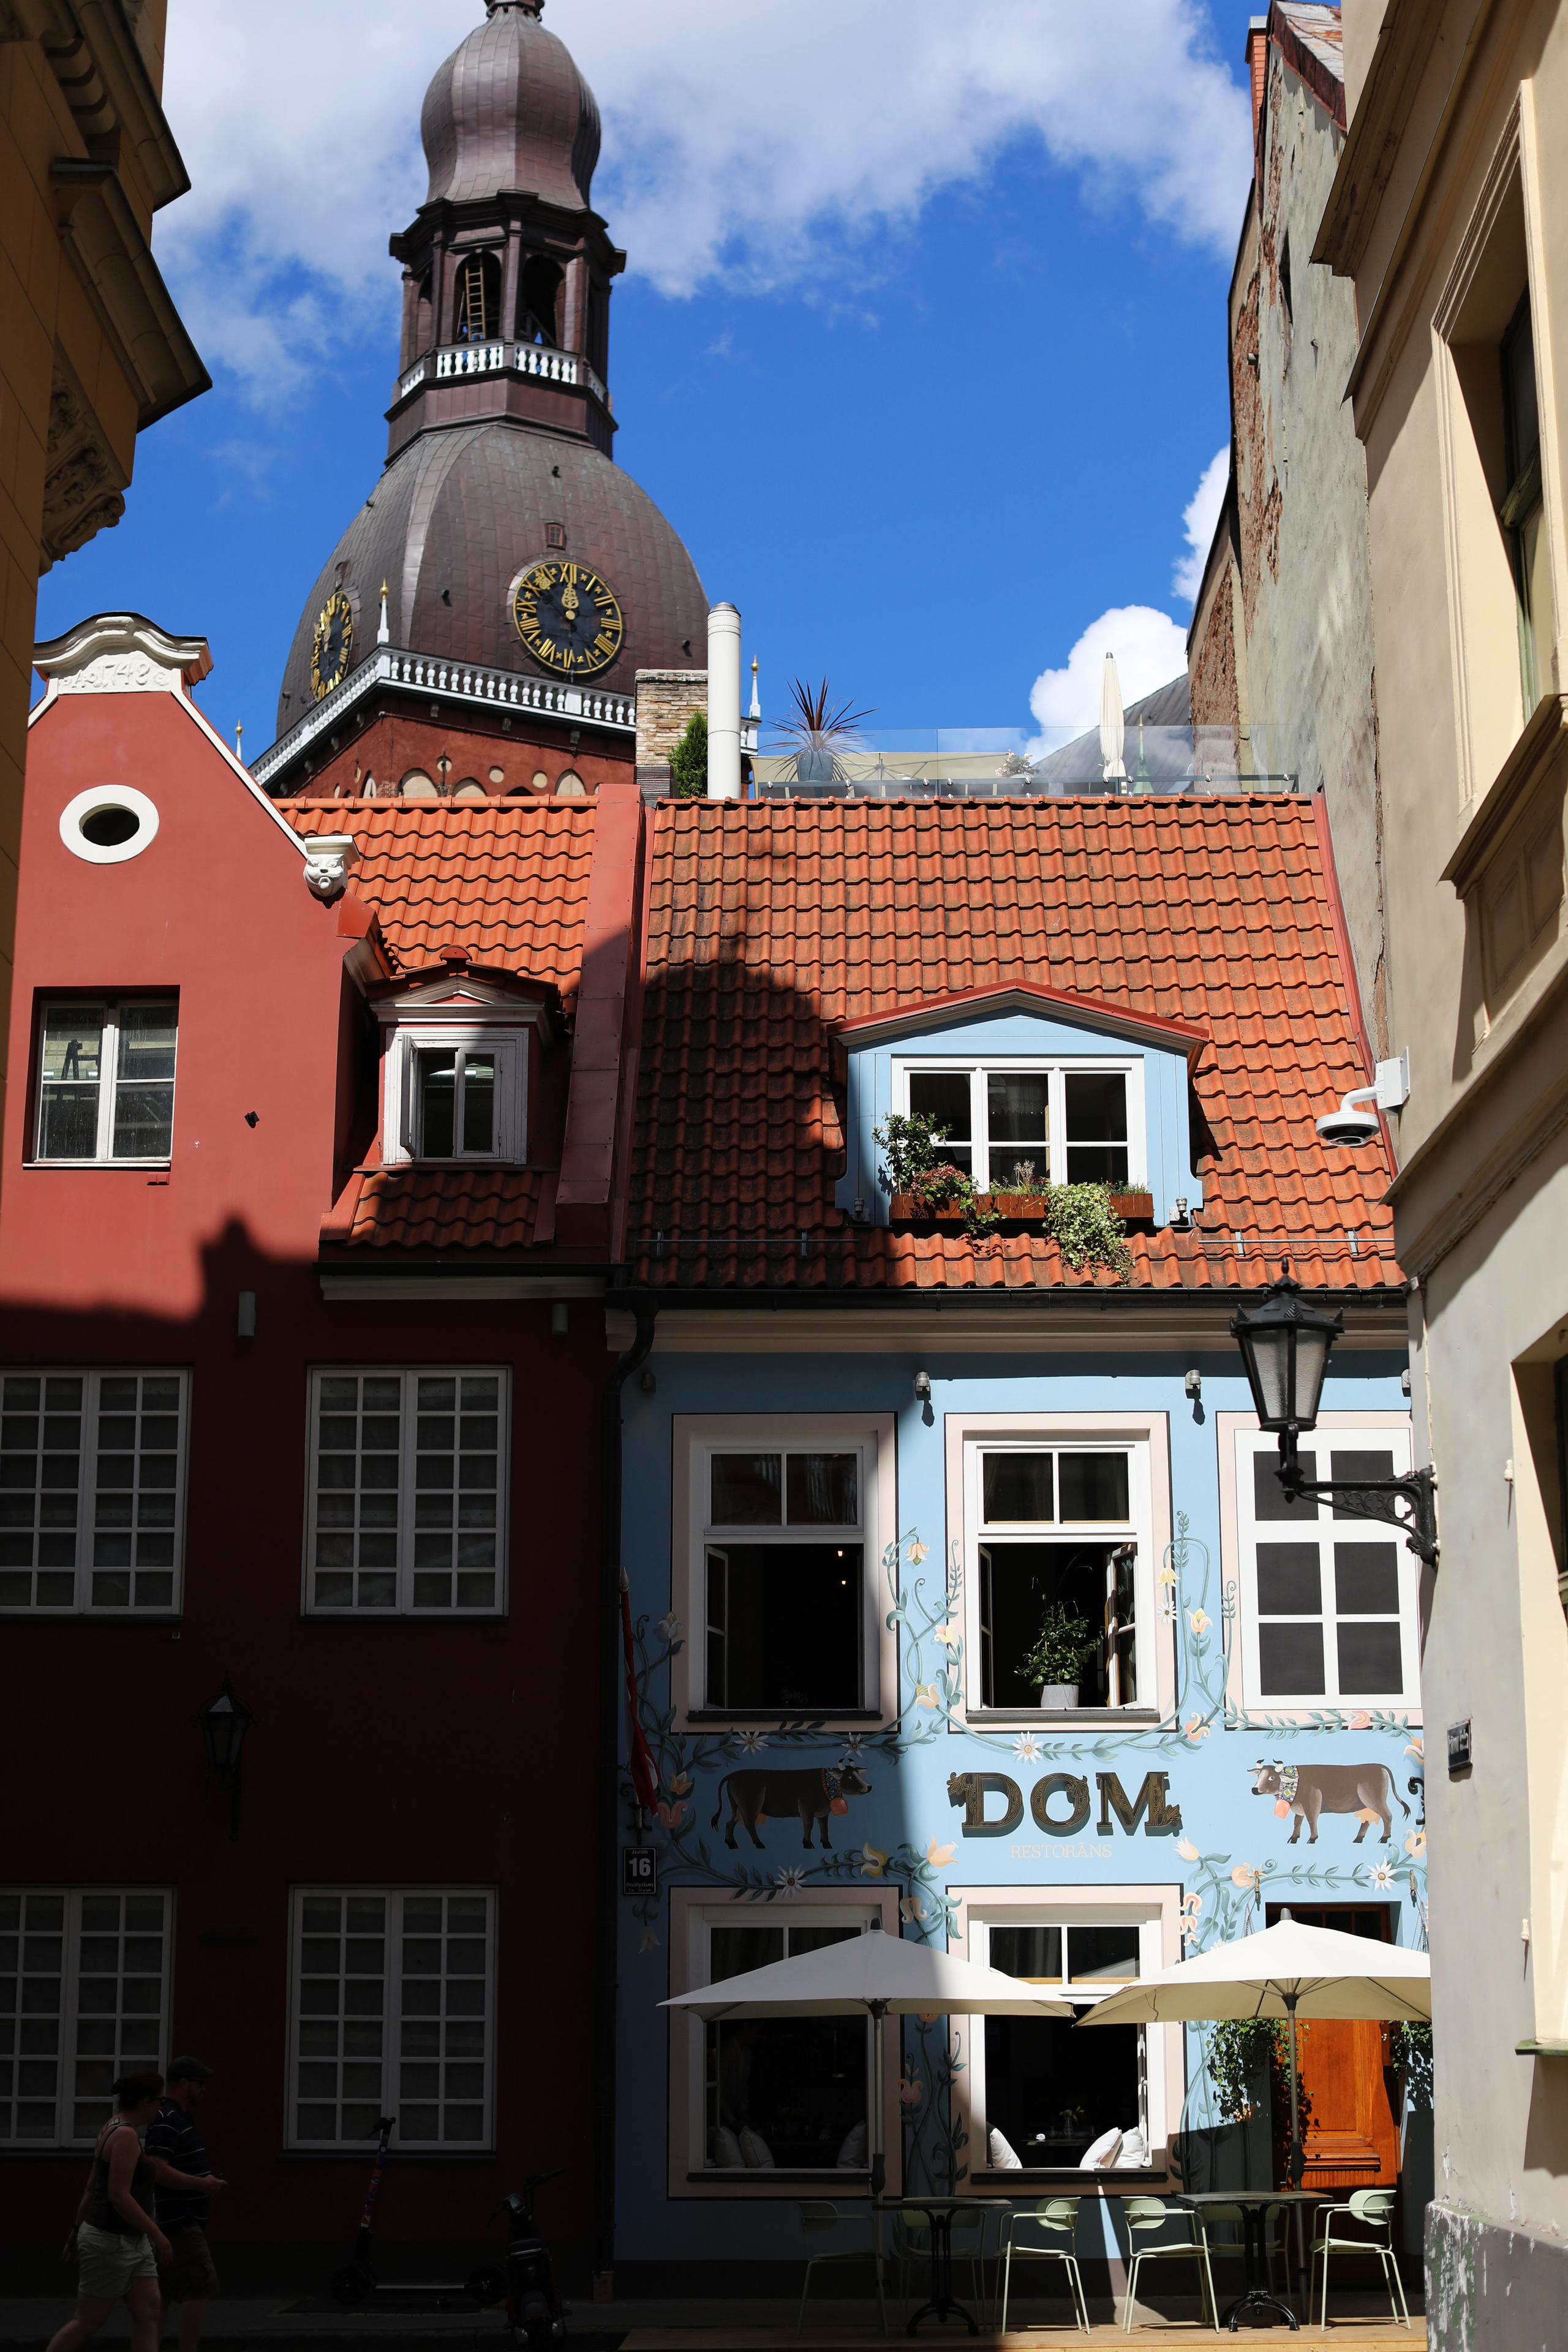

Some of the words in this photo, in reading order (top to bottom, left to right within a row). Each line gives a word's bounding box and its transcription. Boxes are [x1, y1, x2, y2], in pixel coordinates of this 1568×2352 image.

[559, 563, 577, 584] XII
[521, 578, 541, 597] X
[516, 597, 537, 613] IX
[594, 595, 614, 607] II
[519, 617, 541, 643] VIII
[600, 617, 620, 631] III
[538, 638, 556, 663] VII
[594, 633, 616, 656] IIII
[563, 648, 576, 669] VI
[584, 648, 600, 668] V
[946, 1771, 1183, 1837] DOM
[1010, 1842, 1112, 1858] RESTORĀNS
[629, 1858, 650, 1876] 16
